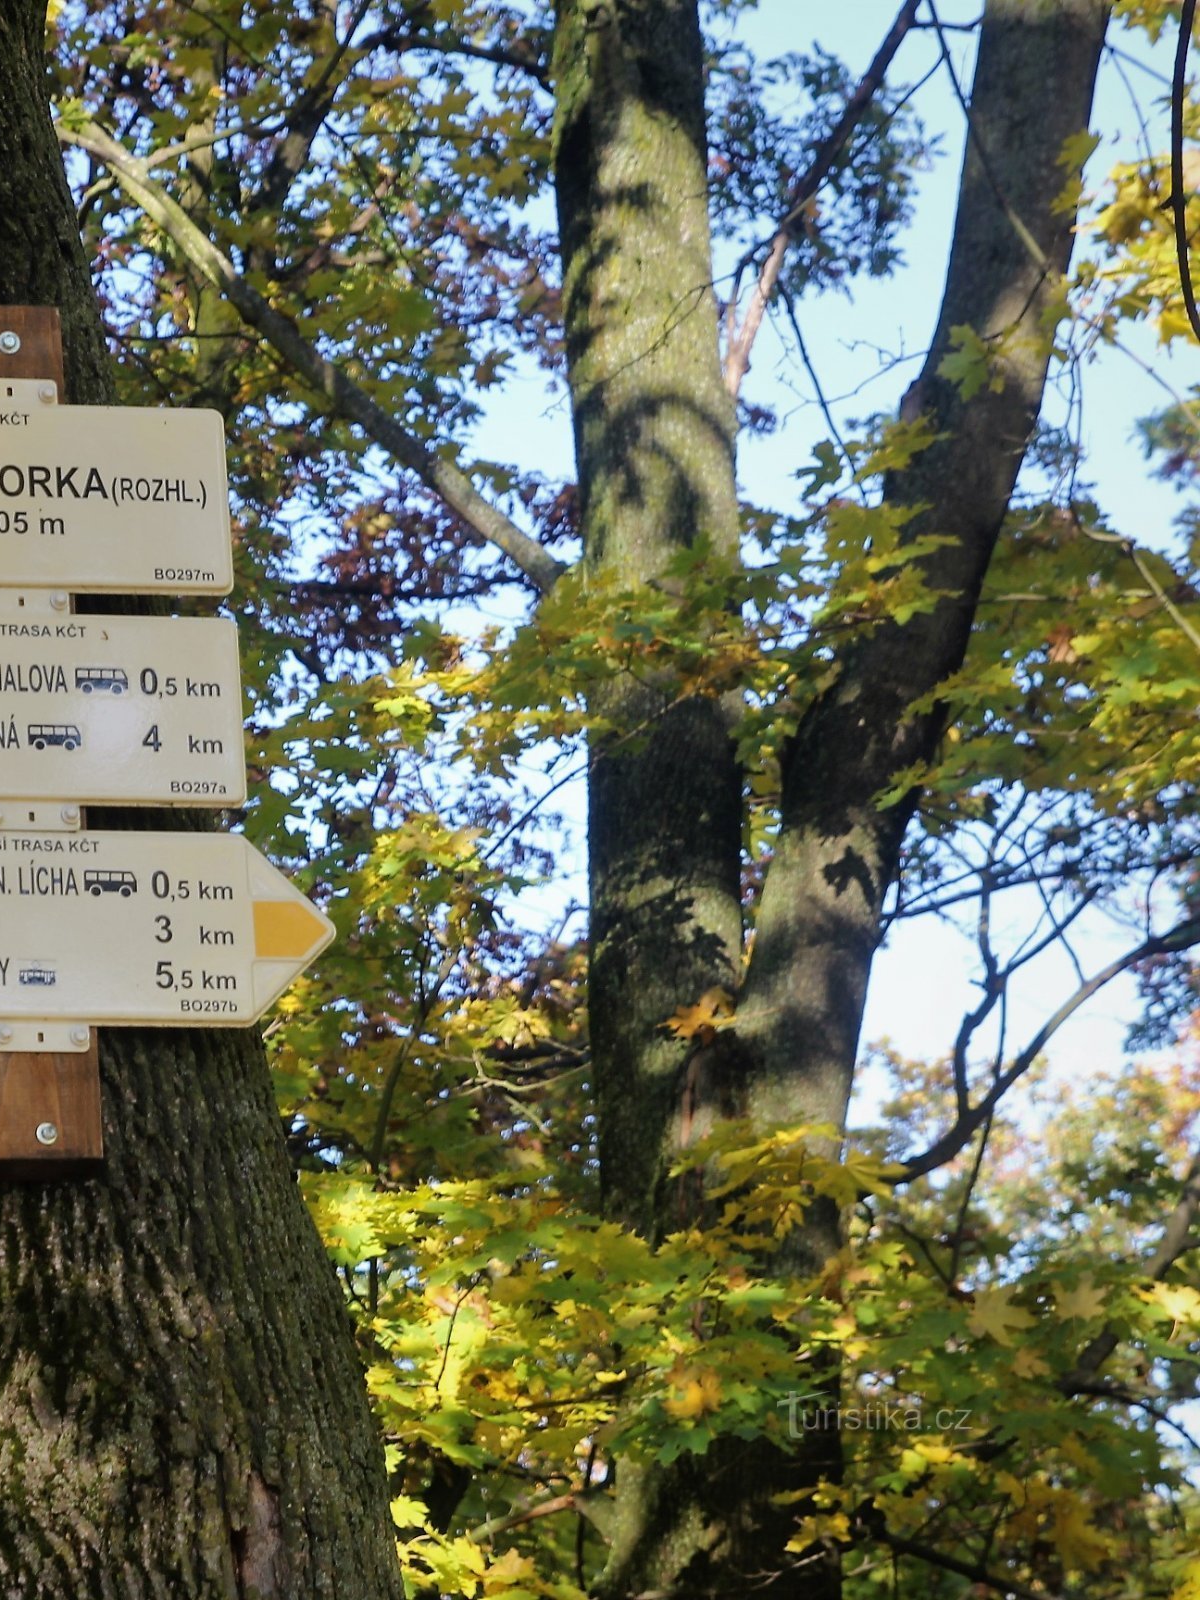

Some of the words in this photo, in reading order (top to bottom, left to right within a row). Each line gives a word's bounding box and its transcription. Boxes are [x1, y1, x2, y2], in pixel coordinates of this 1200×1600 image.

[0, 412, 30, 426] KČT
[39, 516, 65, 535] m
[154, 568, 215, 581] BO297m
[0, 624, 51, 637] TRASA
[56, 623, 86, 638] KČT
[139, 667, 178, 699] 0,5
[186, 678, 221, 697] km
[142, 725, 162, 752] 4
[188, 735, 223, 754] km
[170, 781, 227, 794] BO297a
[12, 839, 64, 852] TRASA
[69, 838, 100, 853] KČT
[18, 860, 79, 896] LÍCHA
[151, 870, 190, 902] 0,5
[198, 880, 234, 900] km
[154, 915, 173, 944] 3
[199, 926, 234, 945] km
[155, 961, 193, 993] 5,5
[202, 970, 237, 990] km
[180, 1000, 238, 1012] BO297b
